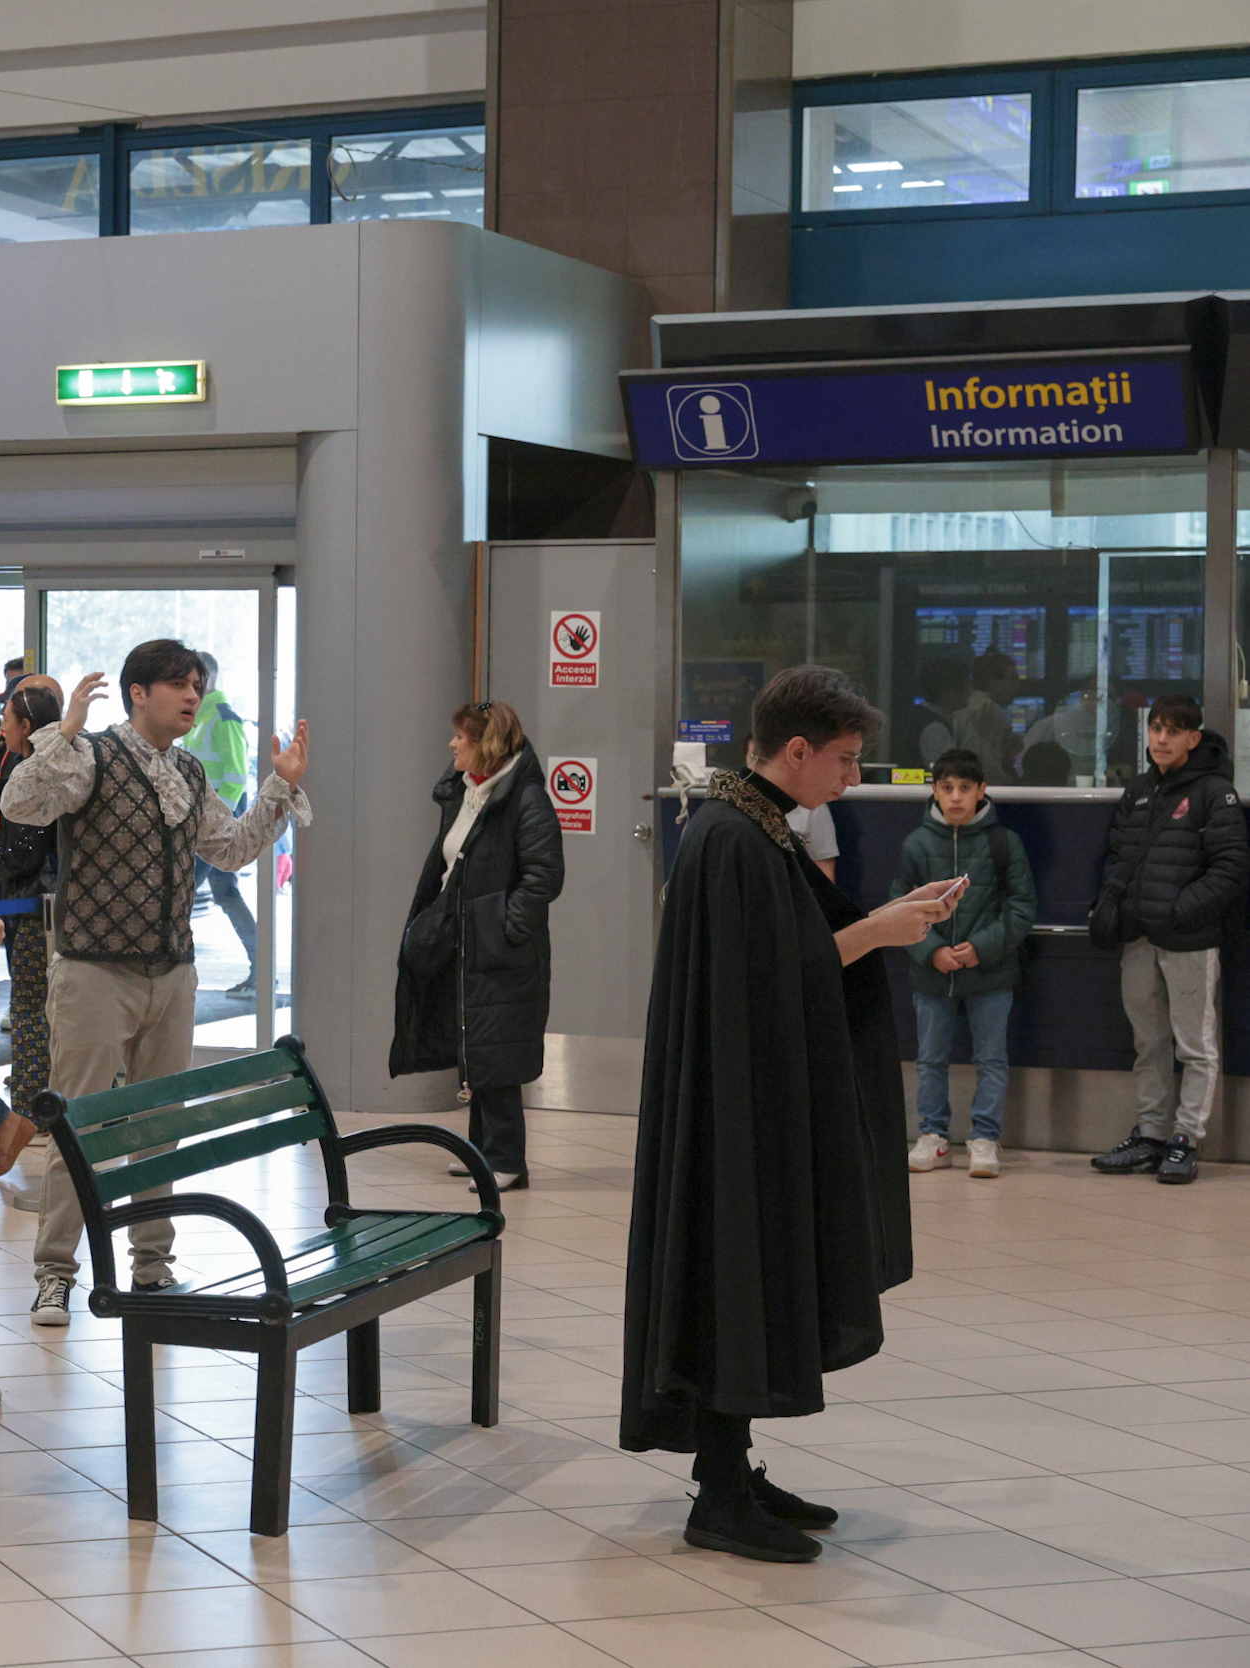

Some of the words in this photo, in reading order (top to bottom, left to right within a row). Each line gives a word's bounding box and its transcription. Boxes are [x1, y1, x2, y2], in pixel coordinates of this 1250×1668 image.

[925, 371, 1133, 415] Informații
[930, 419, 1124, 449] Information
[555, 664, 595, 674] Accesul
[556, 674, 593, 683] interzis
